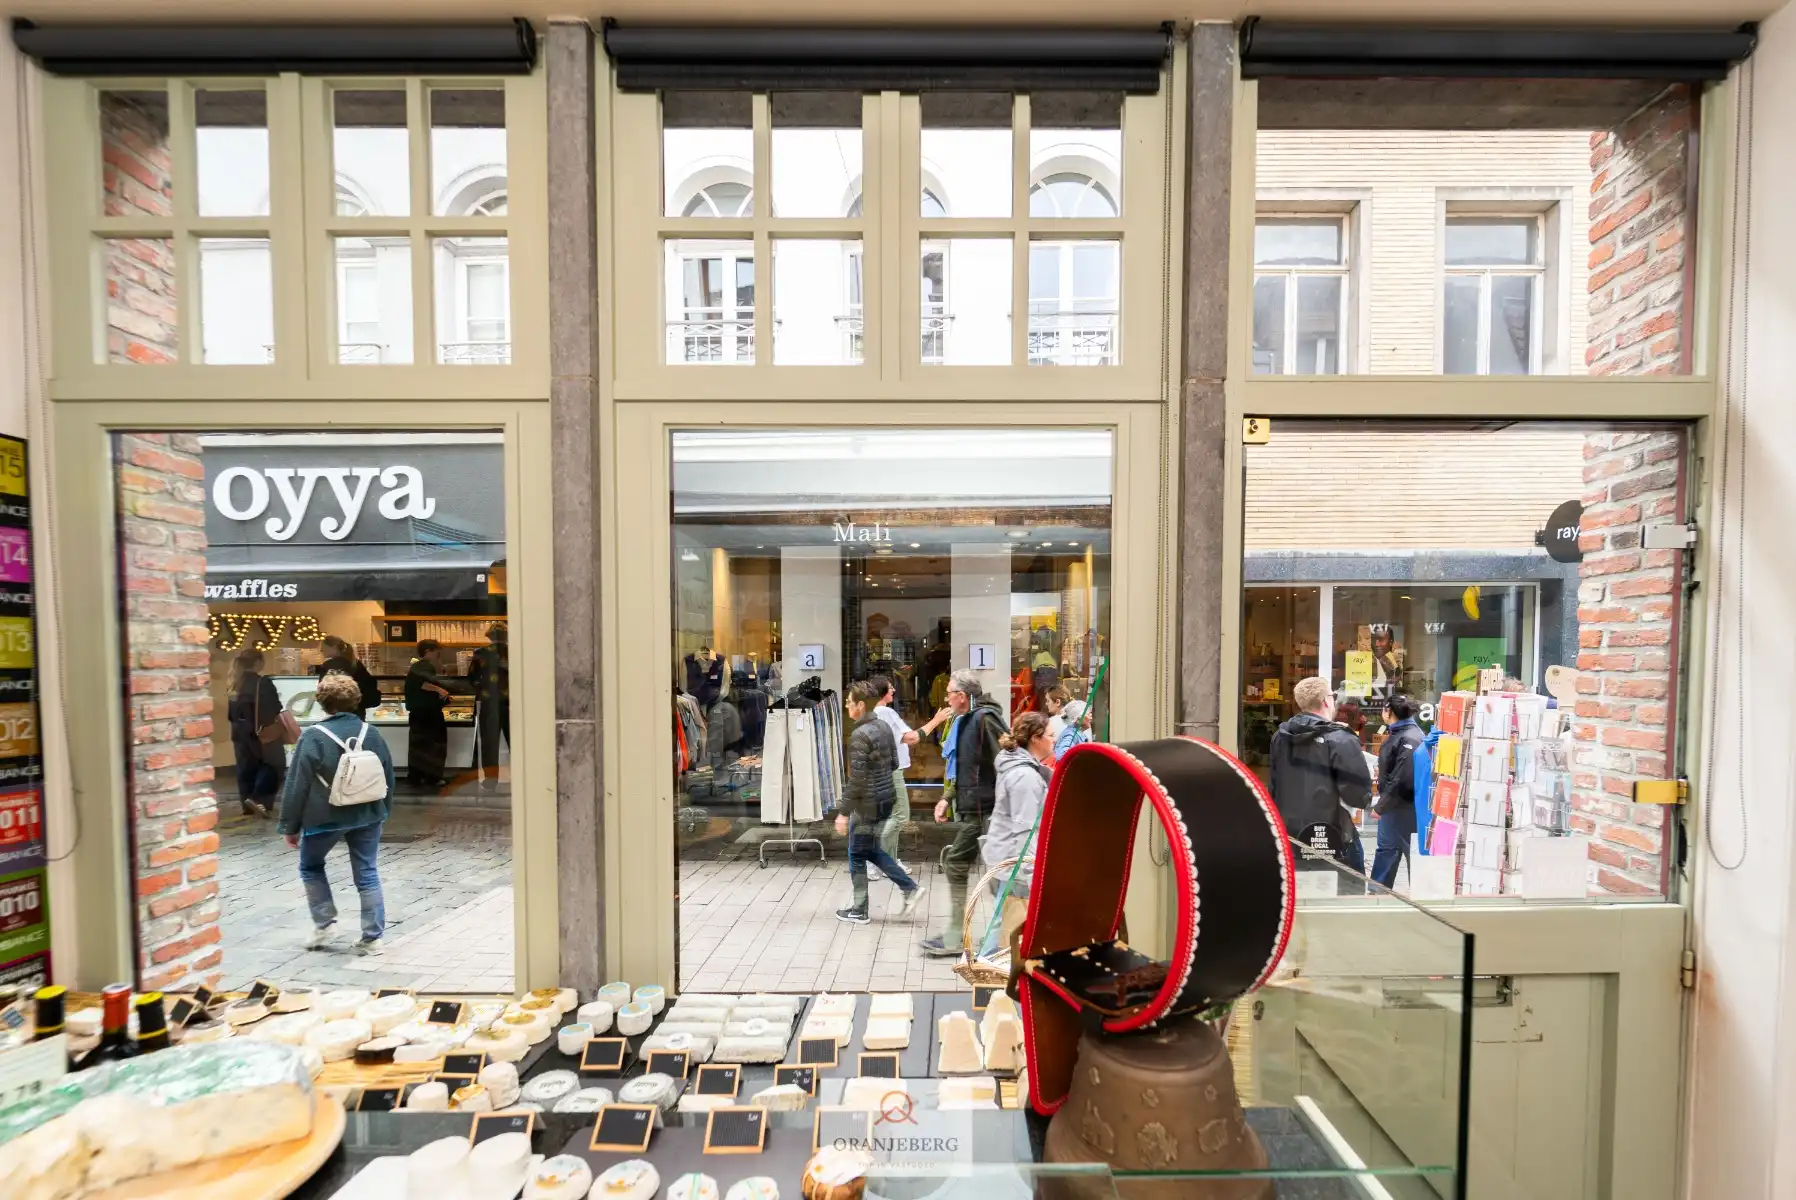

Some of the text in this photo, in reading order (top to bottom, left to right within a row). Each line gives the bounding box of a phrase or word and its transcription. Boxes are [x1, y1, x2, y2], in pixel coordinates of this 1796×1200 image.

[212, 465, 436, 541] oyya
[833, 522, 892, 542] Mali
[204, 579, 298, 598] waffles
[805, 653, 816, 668] a
